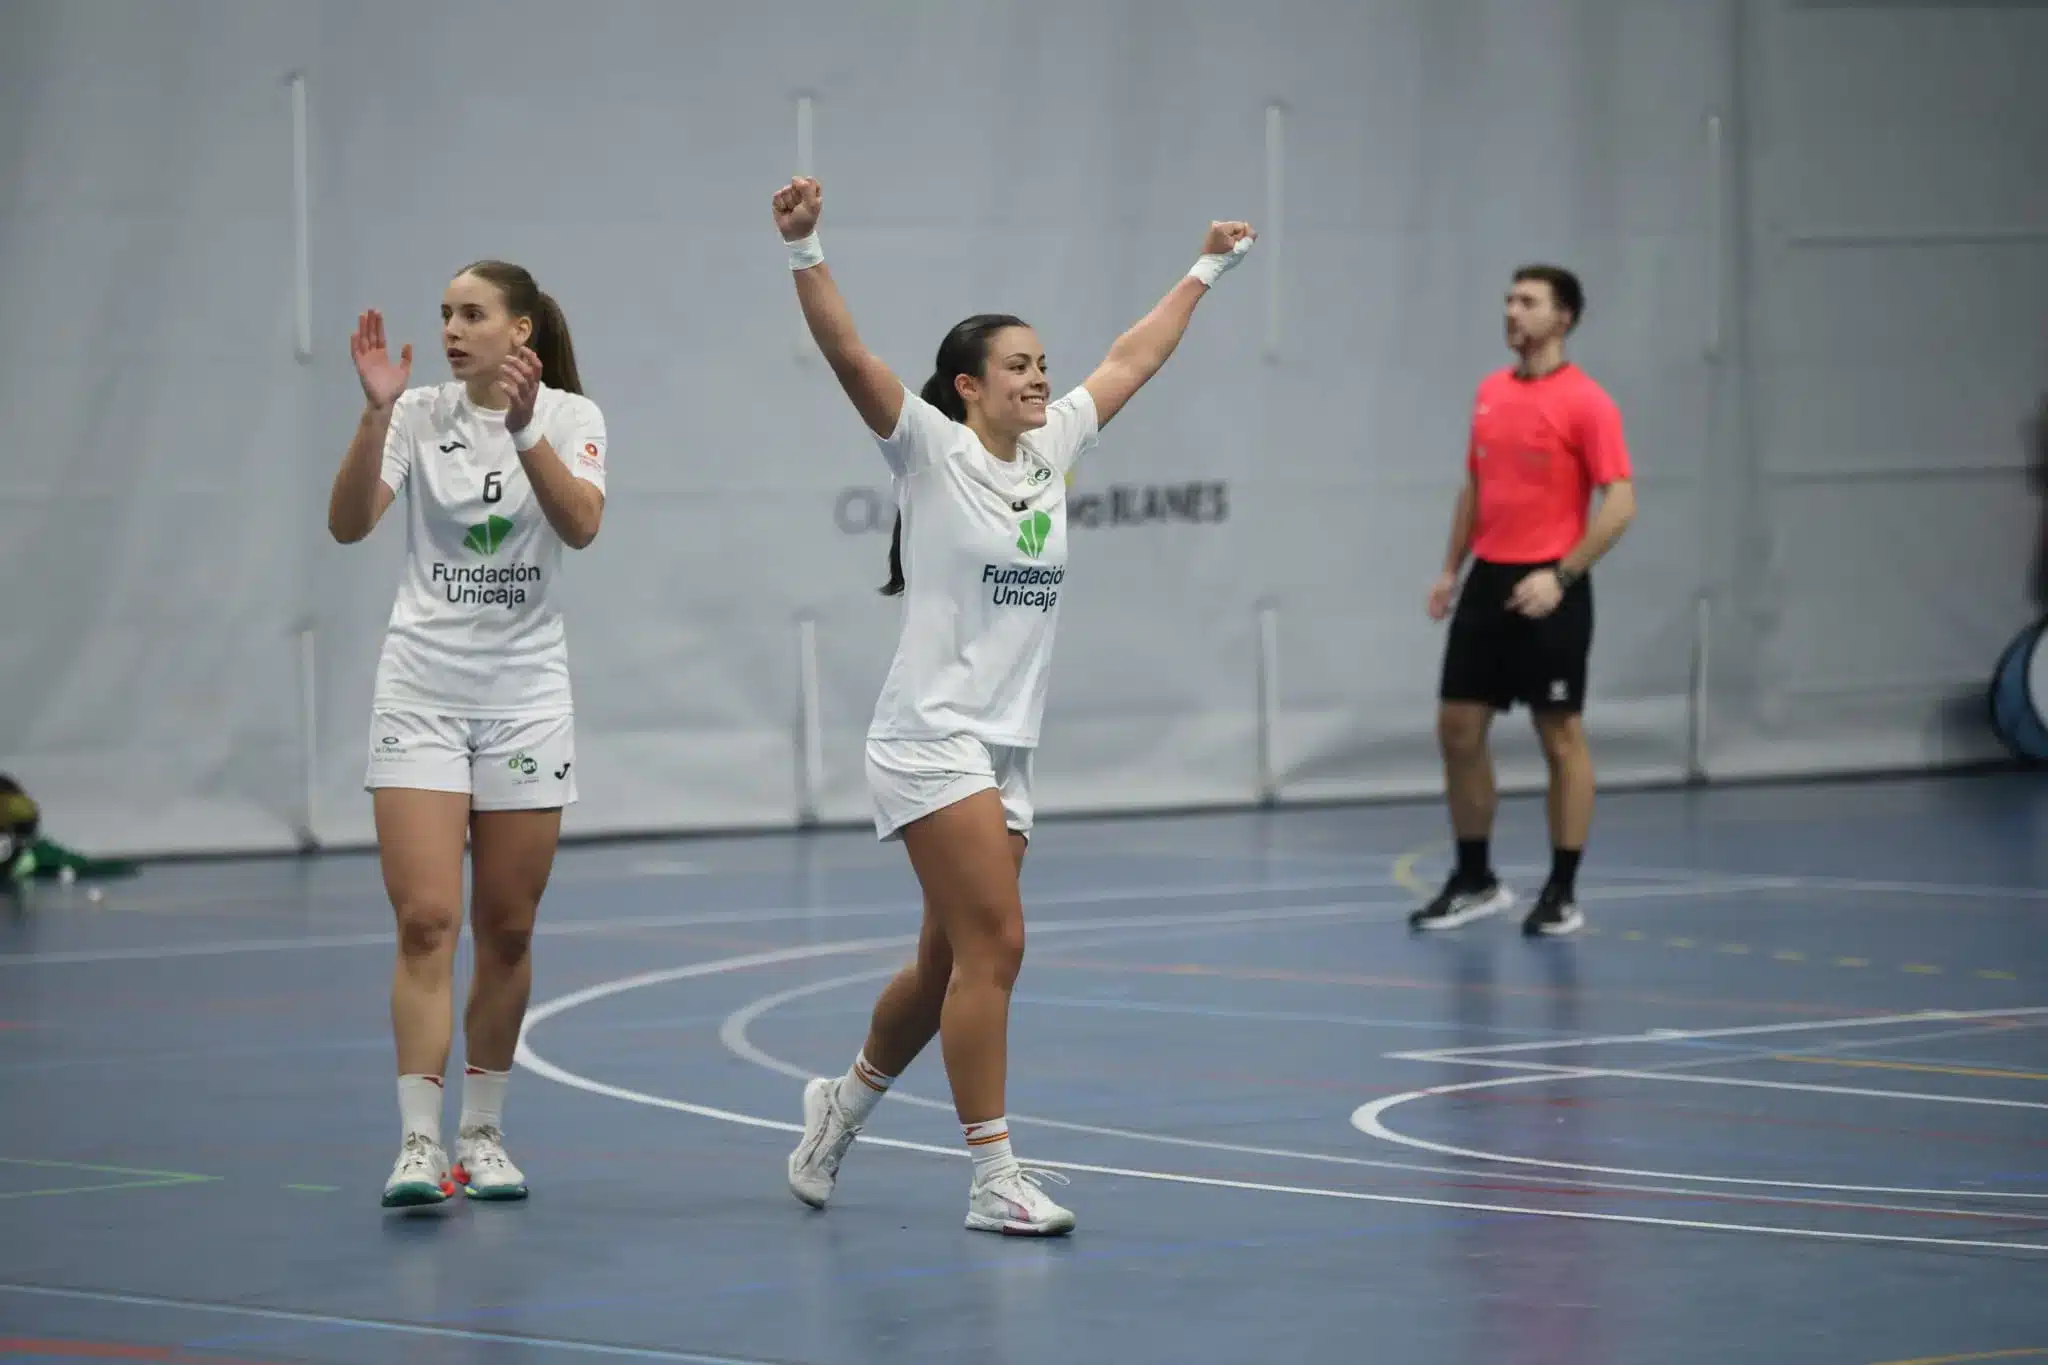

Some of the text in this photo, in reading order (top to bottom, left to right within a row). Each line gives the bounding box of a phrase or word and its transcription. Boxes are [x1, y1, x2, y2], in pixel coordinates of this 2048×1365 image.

[483, 471, 502, 503] 6
[432, 562, 541, 583] Fundación
[982, 564, 1065, 585] Fundació
[446, 583, 526, 609] Unicaja
[993, 585, 1057, 613] Unicaja
